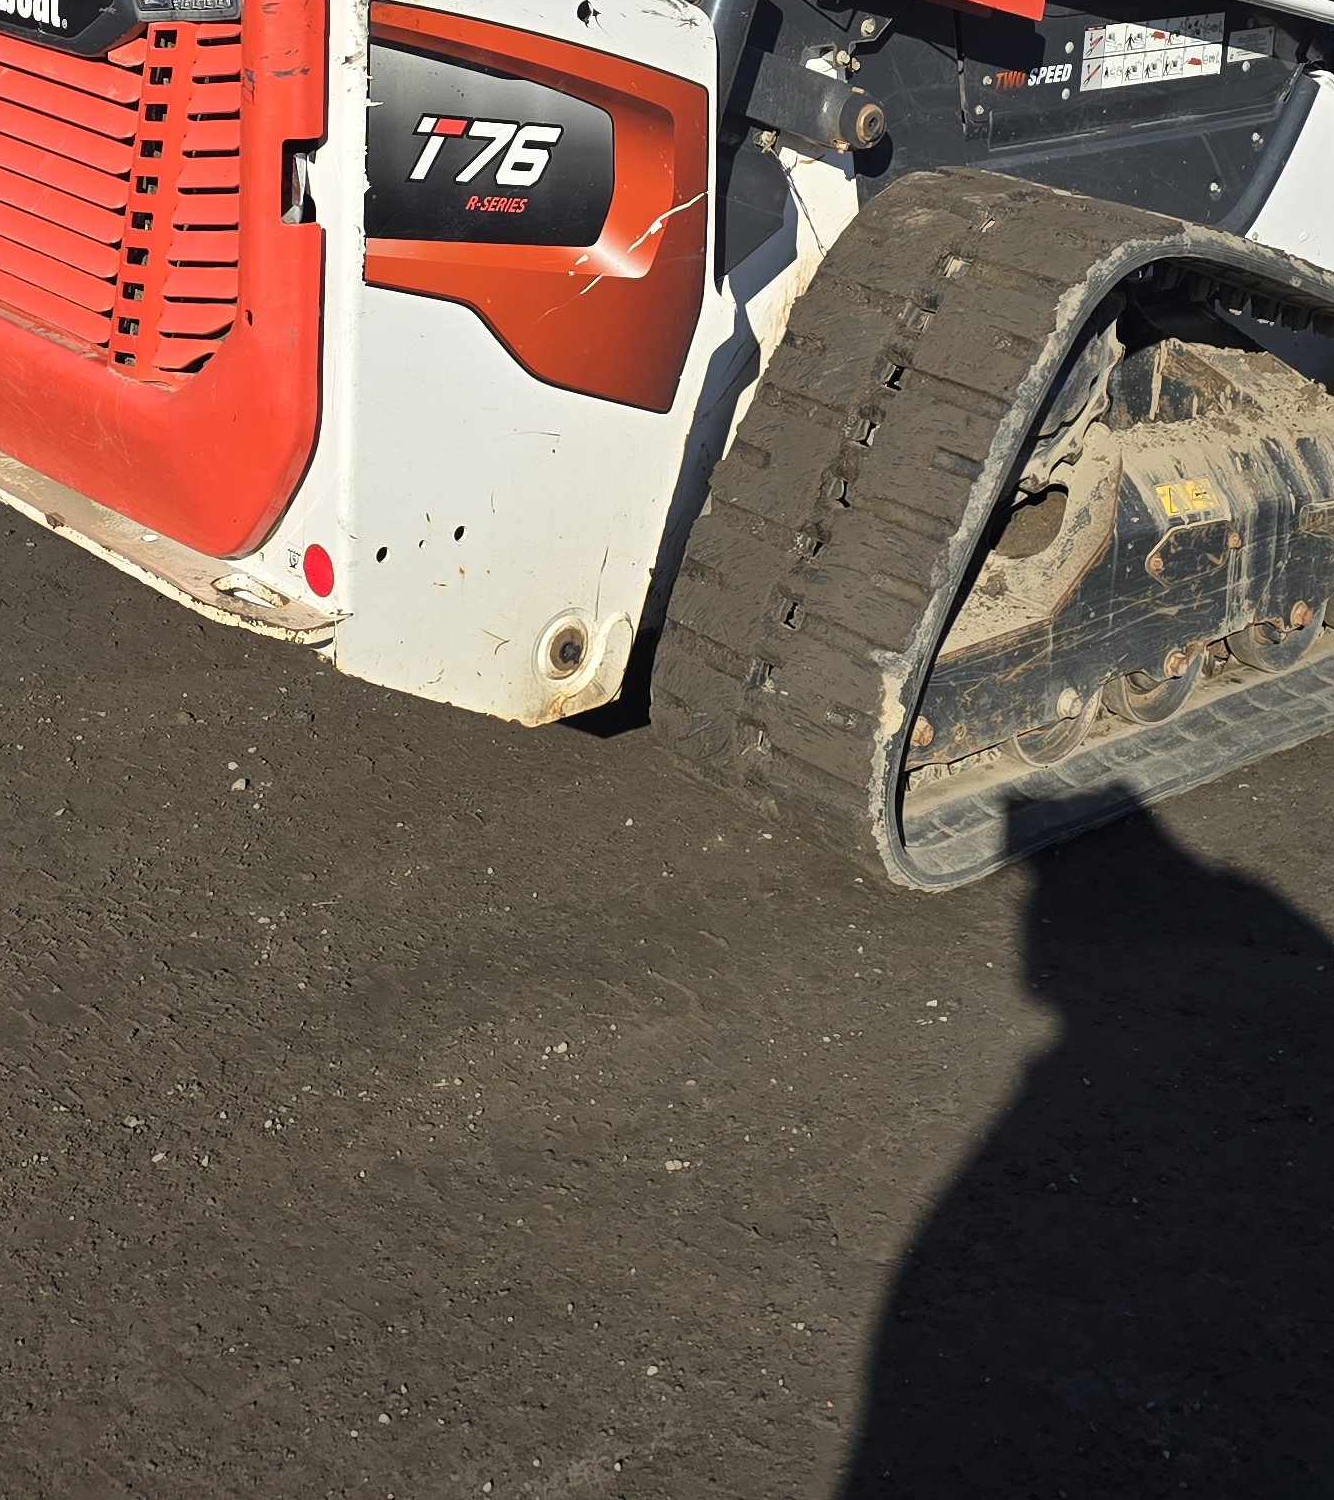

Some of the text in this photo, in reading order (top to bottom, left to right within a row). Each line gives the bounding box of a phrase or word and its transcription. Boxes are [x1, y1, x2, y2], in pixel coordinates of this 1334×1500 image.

[994, 63, 1073, 90] TWO SPEED
[408, 115, 563, 188] T76
[465, 194, 529, 215] R-SERIES
